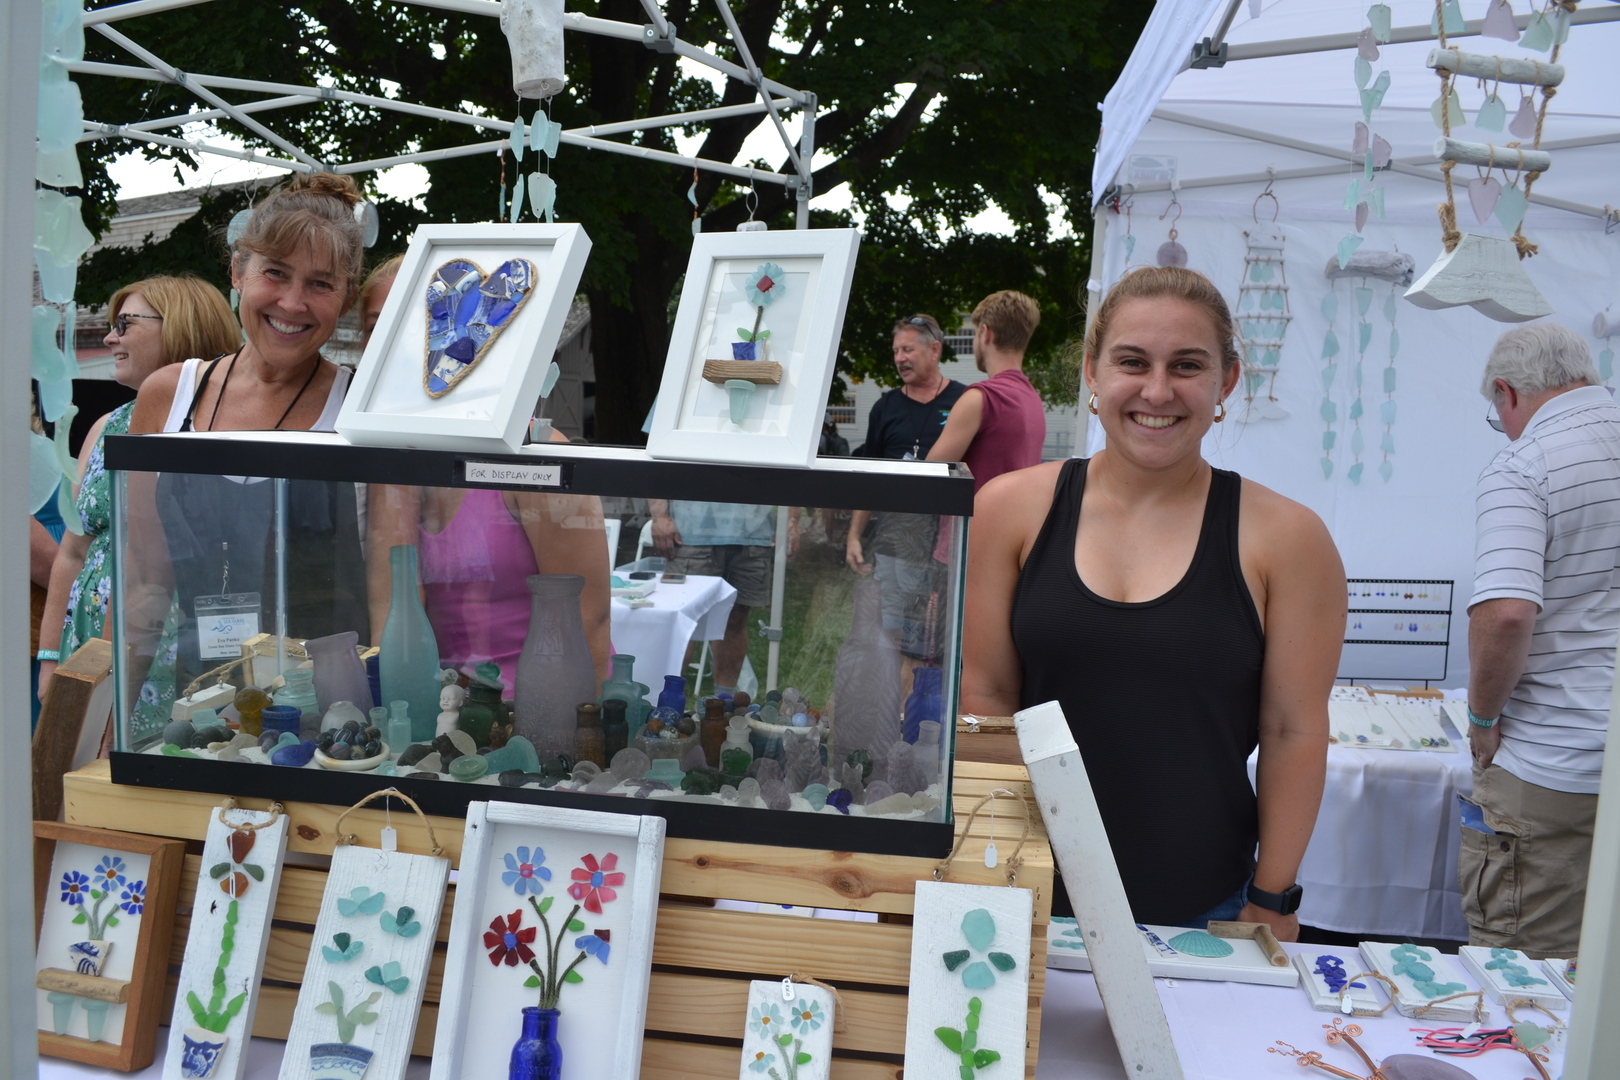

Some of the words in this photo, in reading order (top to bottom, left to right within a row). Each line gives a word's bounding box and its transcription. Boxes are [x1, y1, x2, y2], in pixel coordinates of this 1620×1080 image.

[470, 469, 486, 479] FOR
[491, 469, 529, 480] DISPLAY
[532, 472, 552, 481] ONLY
